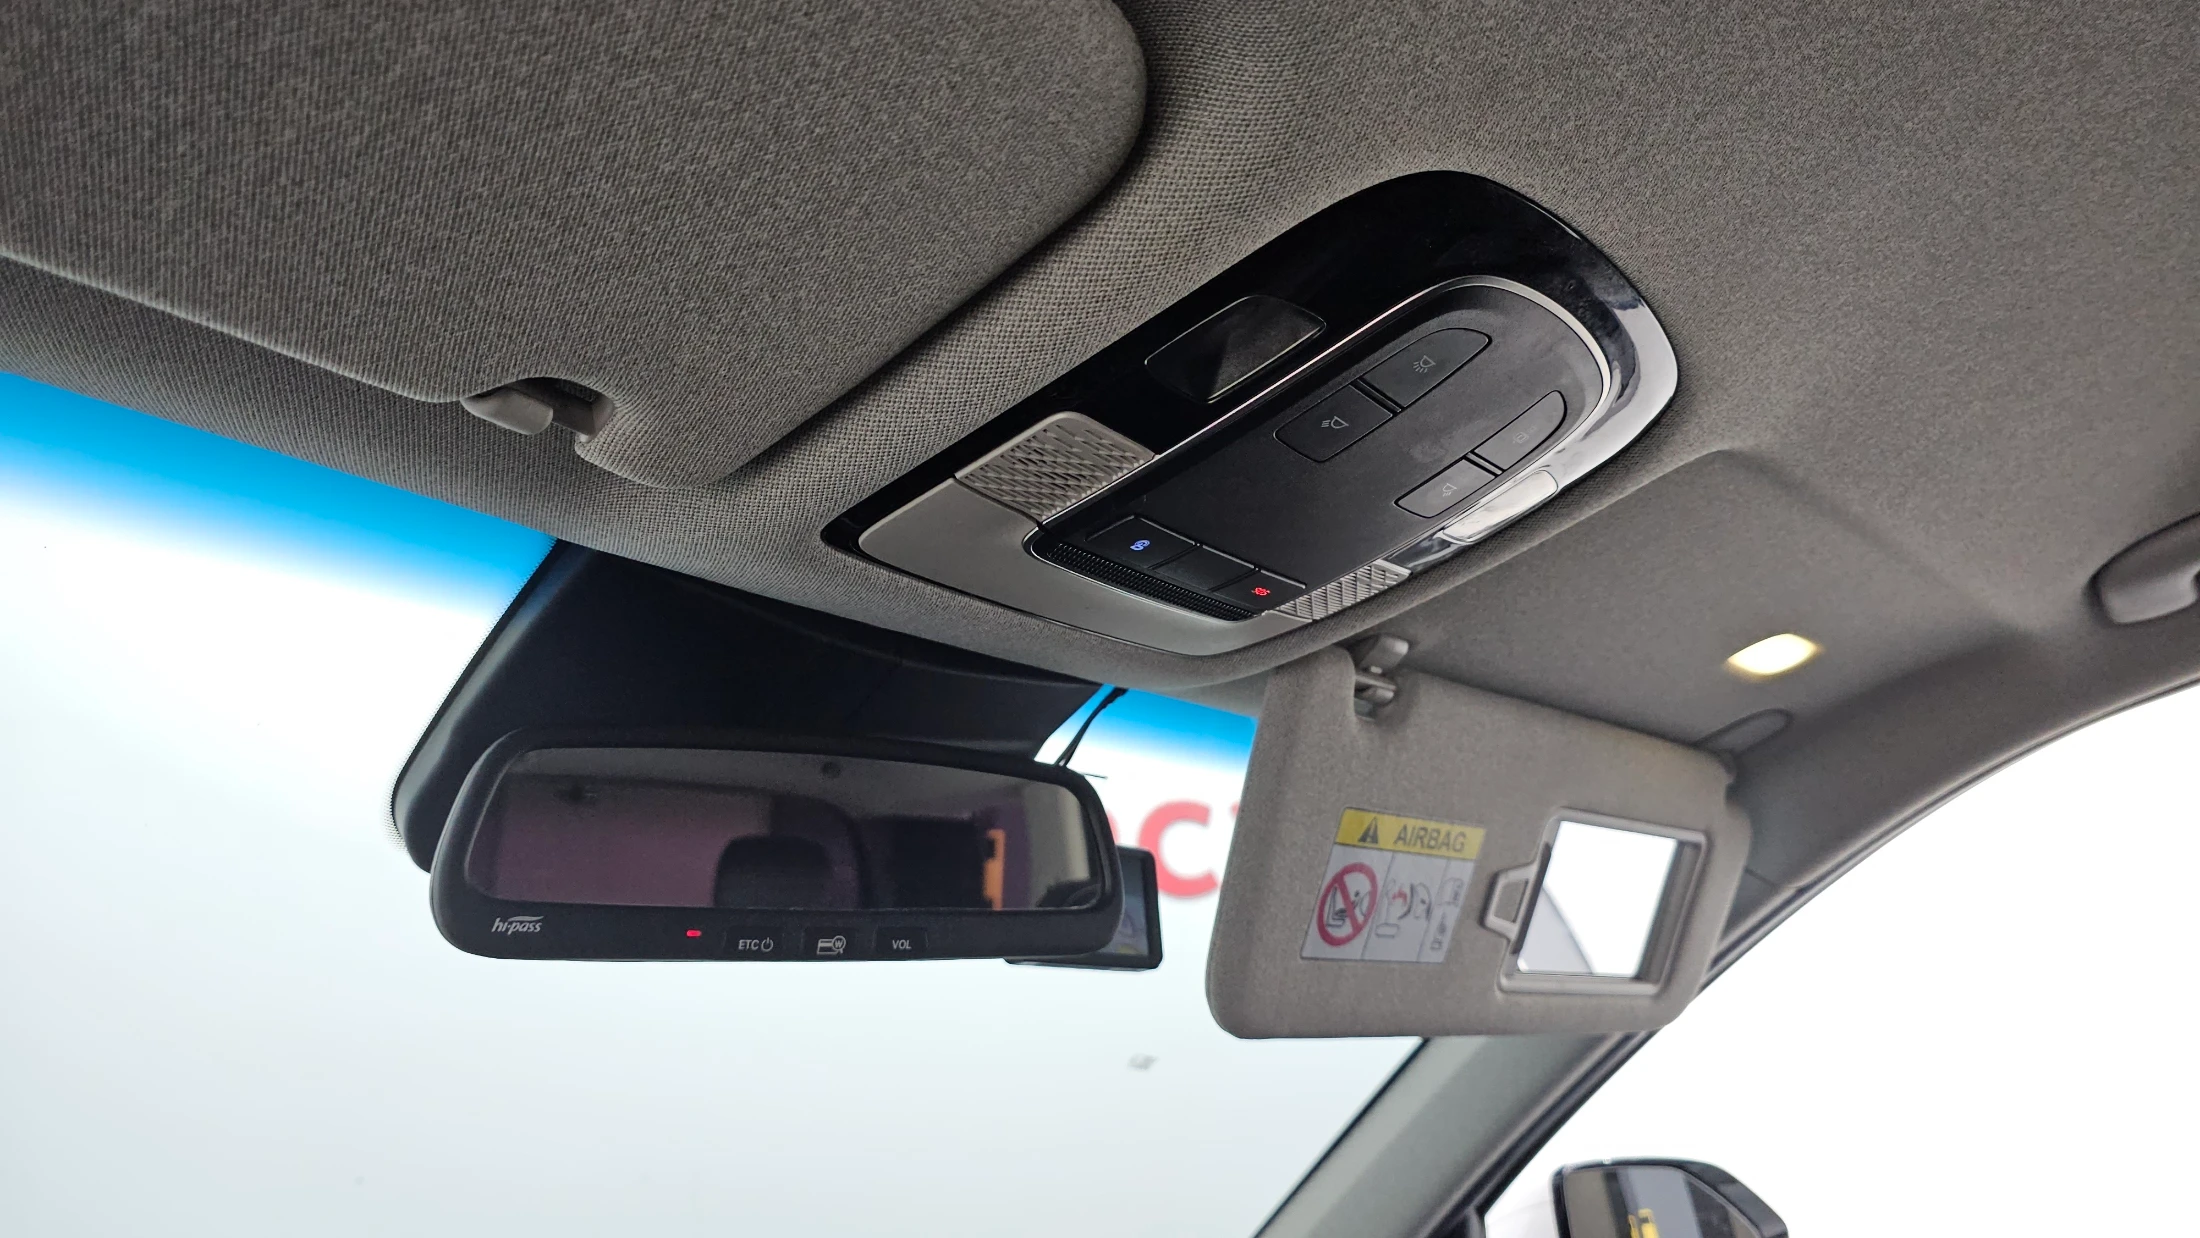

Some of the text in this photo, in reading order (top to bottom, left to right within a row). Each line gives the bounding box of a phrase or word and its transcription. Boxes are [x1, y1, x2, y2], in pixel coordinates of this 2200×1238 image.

[1393, 824, 1467, 853] AIRBAG
[738, 939, 760, 950] ETC
[892, 939, 912, 950] VOL
